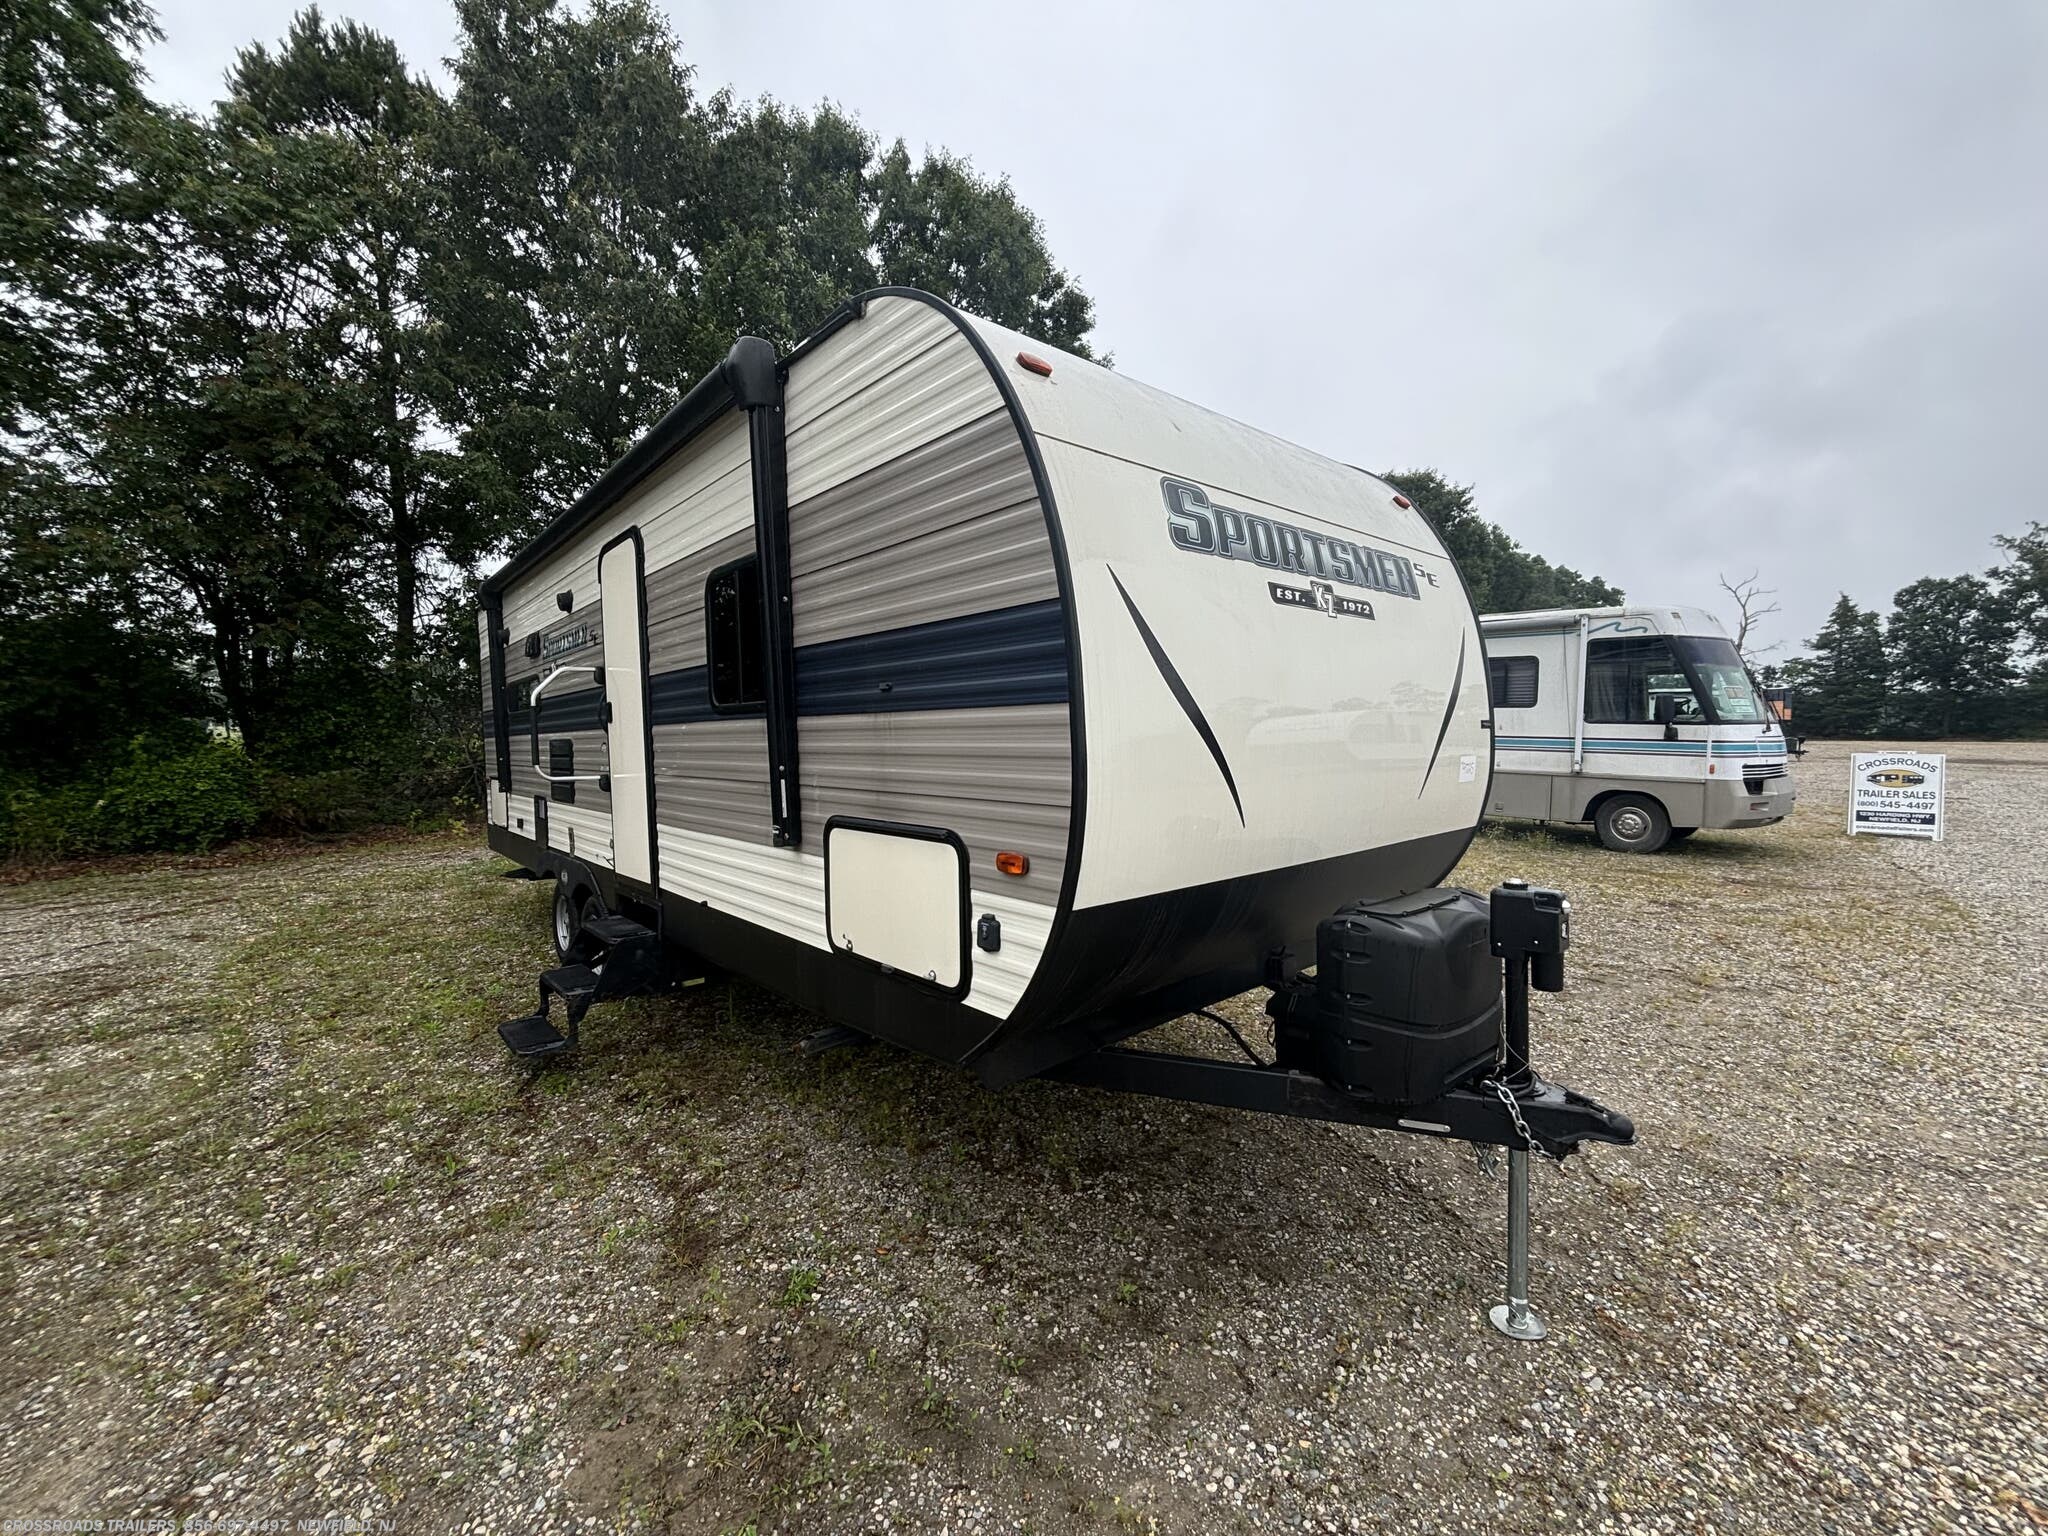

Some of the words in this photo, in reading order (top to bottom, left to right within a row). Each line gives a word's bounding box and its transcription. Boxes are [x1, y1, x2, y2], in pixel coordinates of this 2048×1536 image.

[1414, 563, 1440, 588] SE
[1275, 587, 1306, 603] EST.
[1311, 581, 1337, 618] KZ
[1342, 600, 1371, 614] 1972
[1857, 757, 1938, 773] CROSSROADS
[1857, 789, 1900, 799] TRAILER
[1902, 790, 1936, 800] SALES
[1857, 800, 1878, 808] (800)
[1880, 800, 1935, 810] 545-4497
